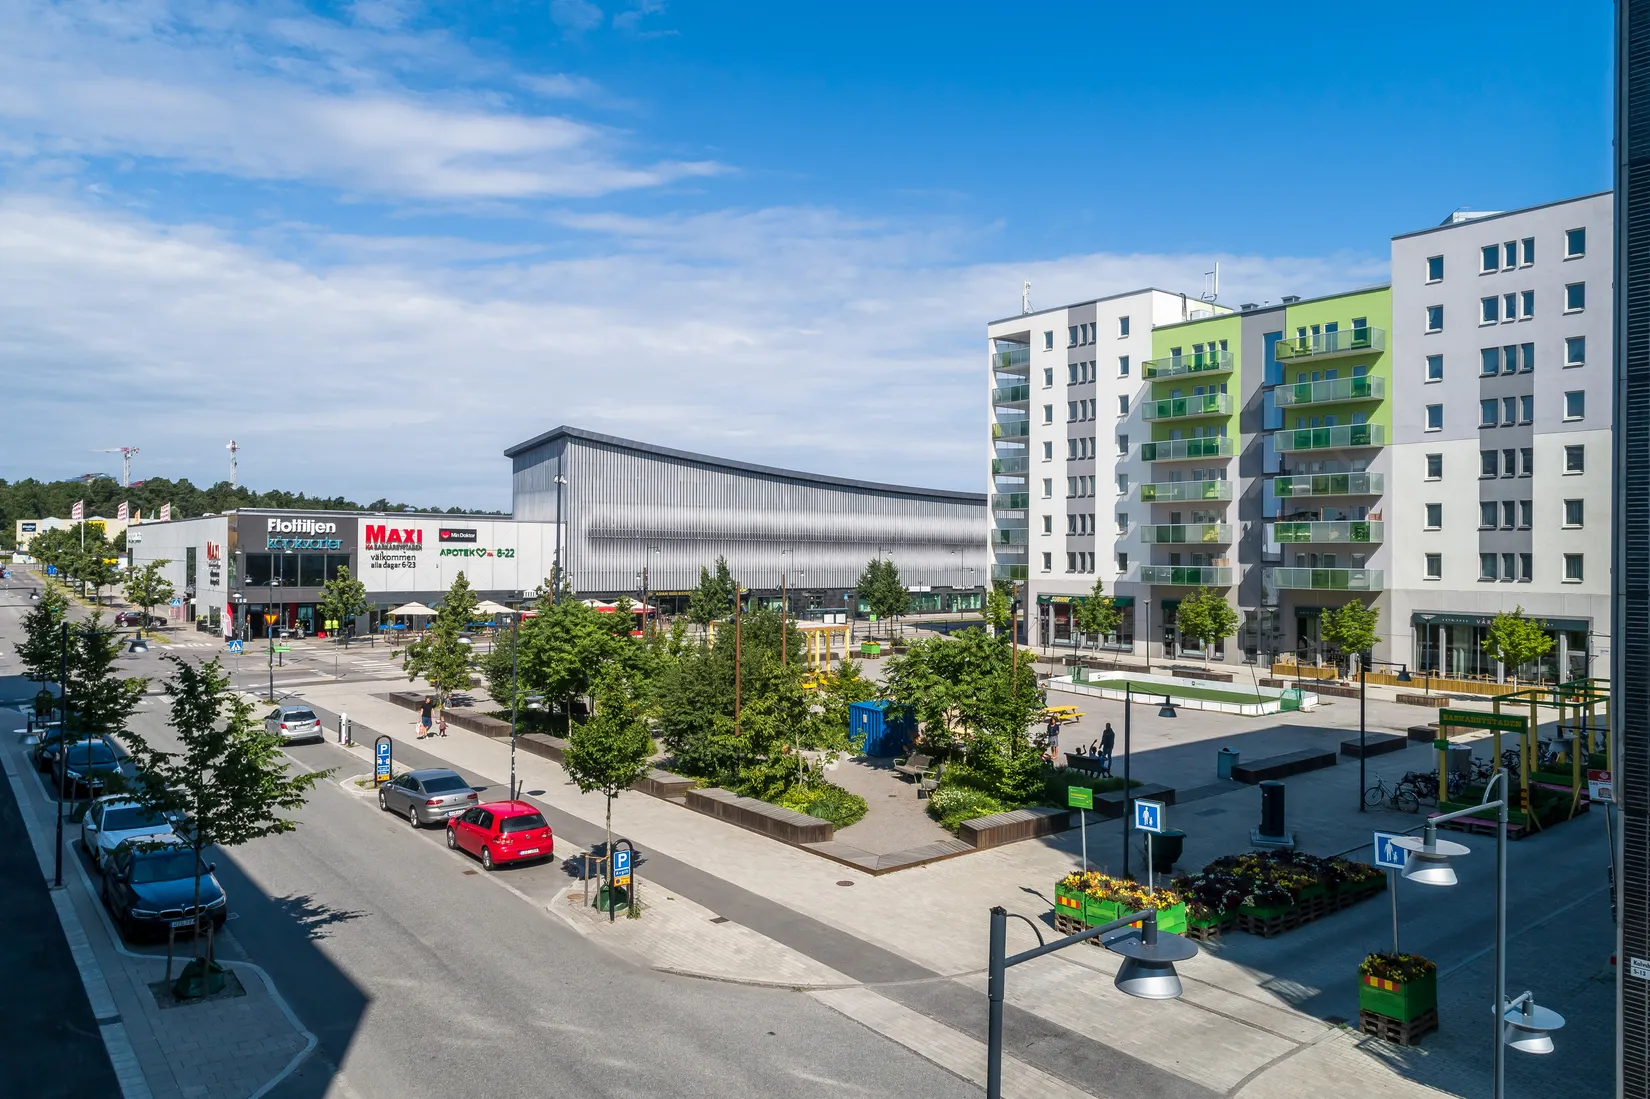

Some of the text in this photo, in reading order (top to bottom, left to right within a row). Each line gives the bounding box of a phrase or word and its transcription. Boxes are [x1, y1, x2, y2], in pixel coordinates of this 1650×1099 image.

[268, 518, 336, 536] Flottiljen
[366, 524, 422, 542] MAXI
[267, 536, 343, 550] köpkvarter
[371, 552, 416, 560] välkommen
[440, 548, 475, 556] APOTEK
[497, 548, 514, 558] 8-22
[383, 562, 400, 570] dagar
[380, 744, 388, 754] P
[618, 854, 628, 868] P
